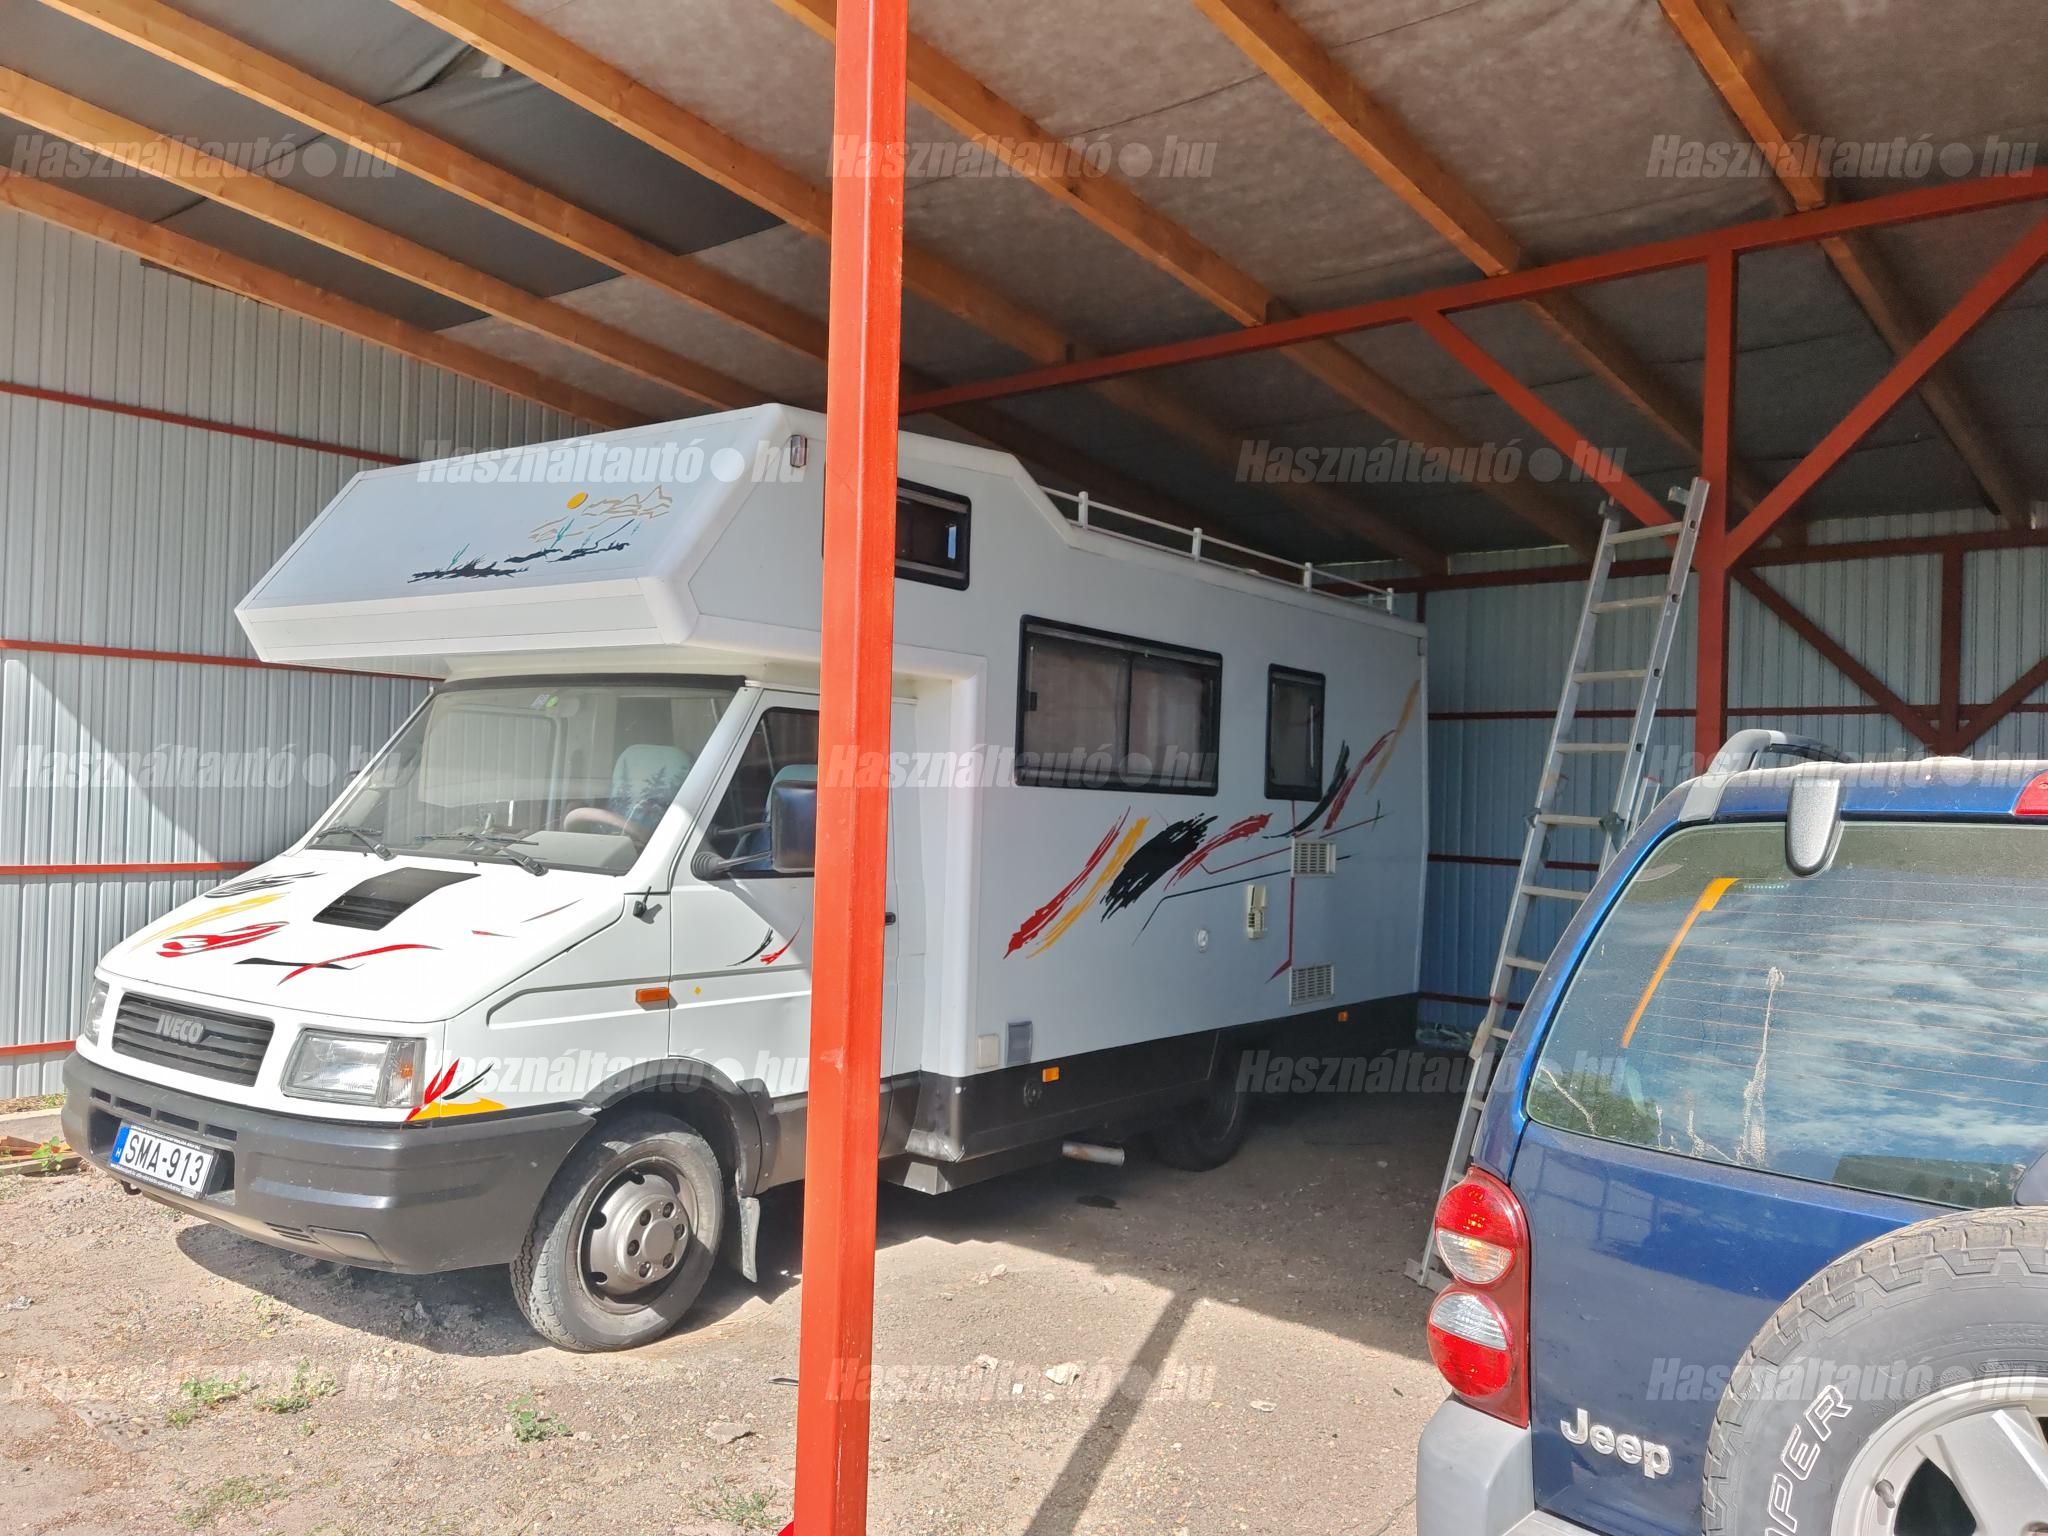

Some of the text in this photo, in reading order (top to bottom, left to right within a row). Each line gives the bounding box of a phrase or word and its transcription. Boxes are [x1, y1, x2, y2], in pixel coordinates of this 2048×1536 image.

[155, 1014, 205, 1043] IVECO
[124, 1133, 205, 1187] SMA-913
[1560, 1407, 1672, 1479] Jeep
[1765, 1384, 1853, 1536] PER
